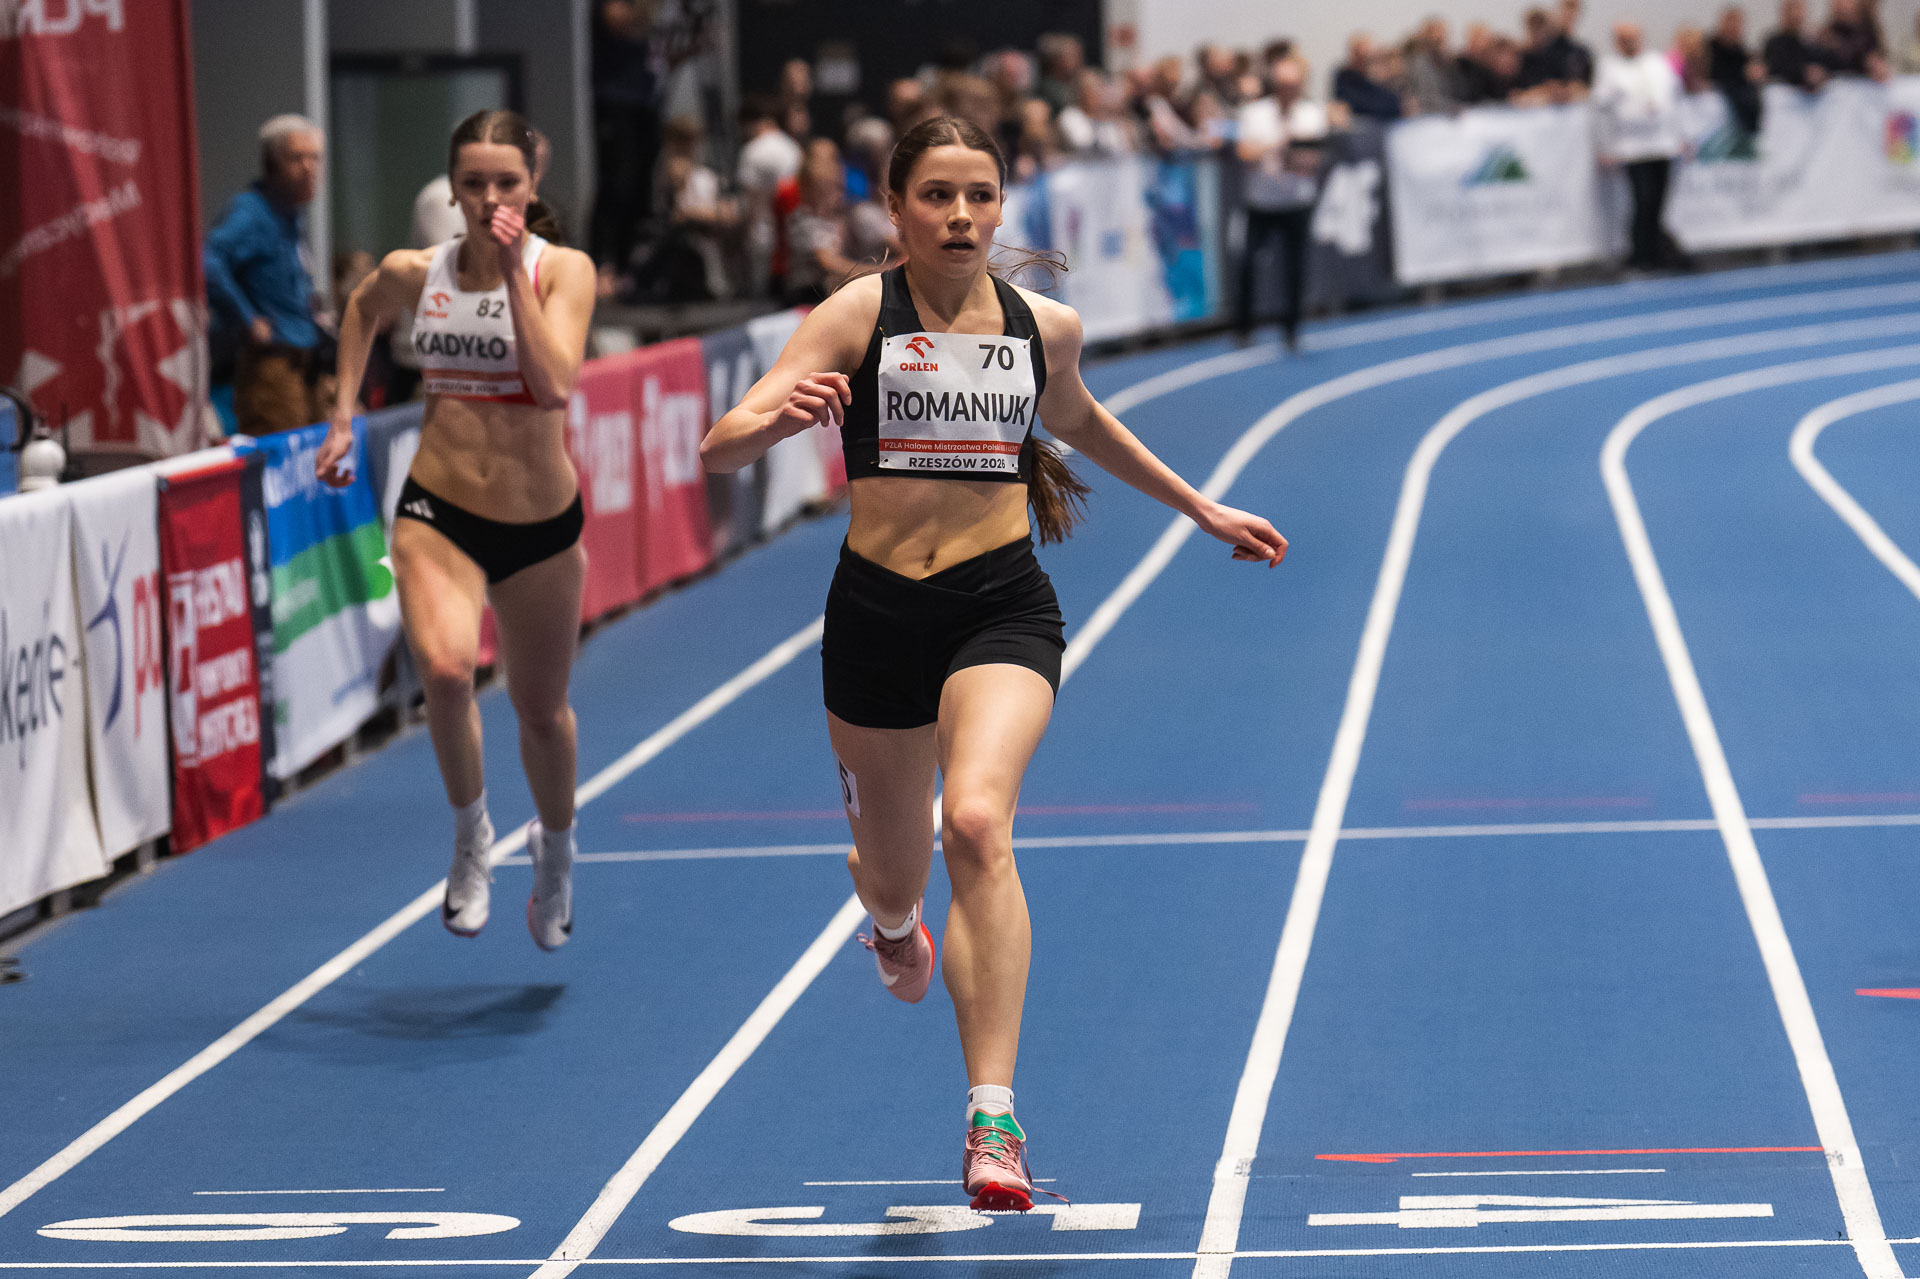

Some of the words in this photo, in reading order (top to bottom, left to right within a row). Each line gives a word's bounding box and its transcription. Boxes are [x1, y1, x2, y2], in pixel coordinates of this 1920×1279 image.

[476, 298, 505, 319] 82
[415, 332, 507, 359] KADYŁO
[899, 362, 939, 372] ORLEN
[978, 343, 1015, 371] 70
[887, 390, 1030, 426] ROMANIUK
[884, 441, 903, 449] PZLA
[904, 442, 933, 450] Halowe
[934, 443, 981, 451] Mistrzostwa
[908, 455, 978, 469] RZESZÓW
[980, 457, 1006, 469] 2026
